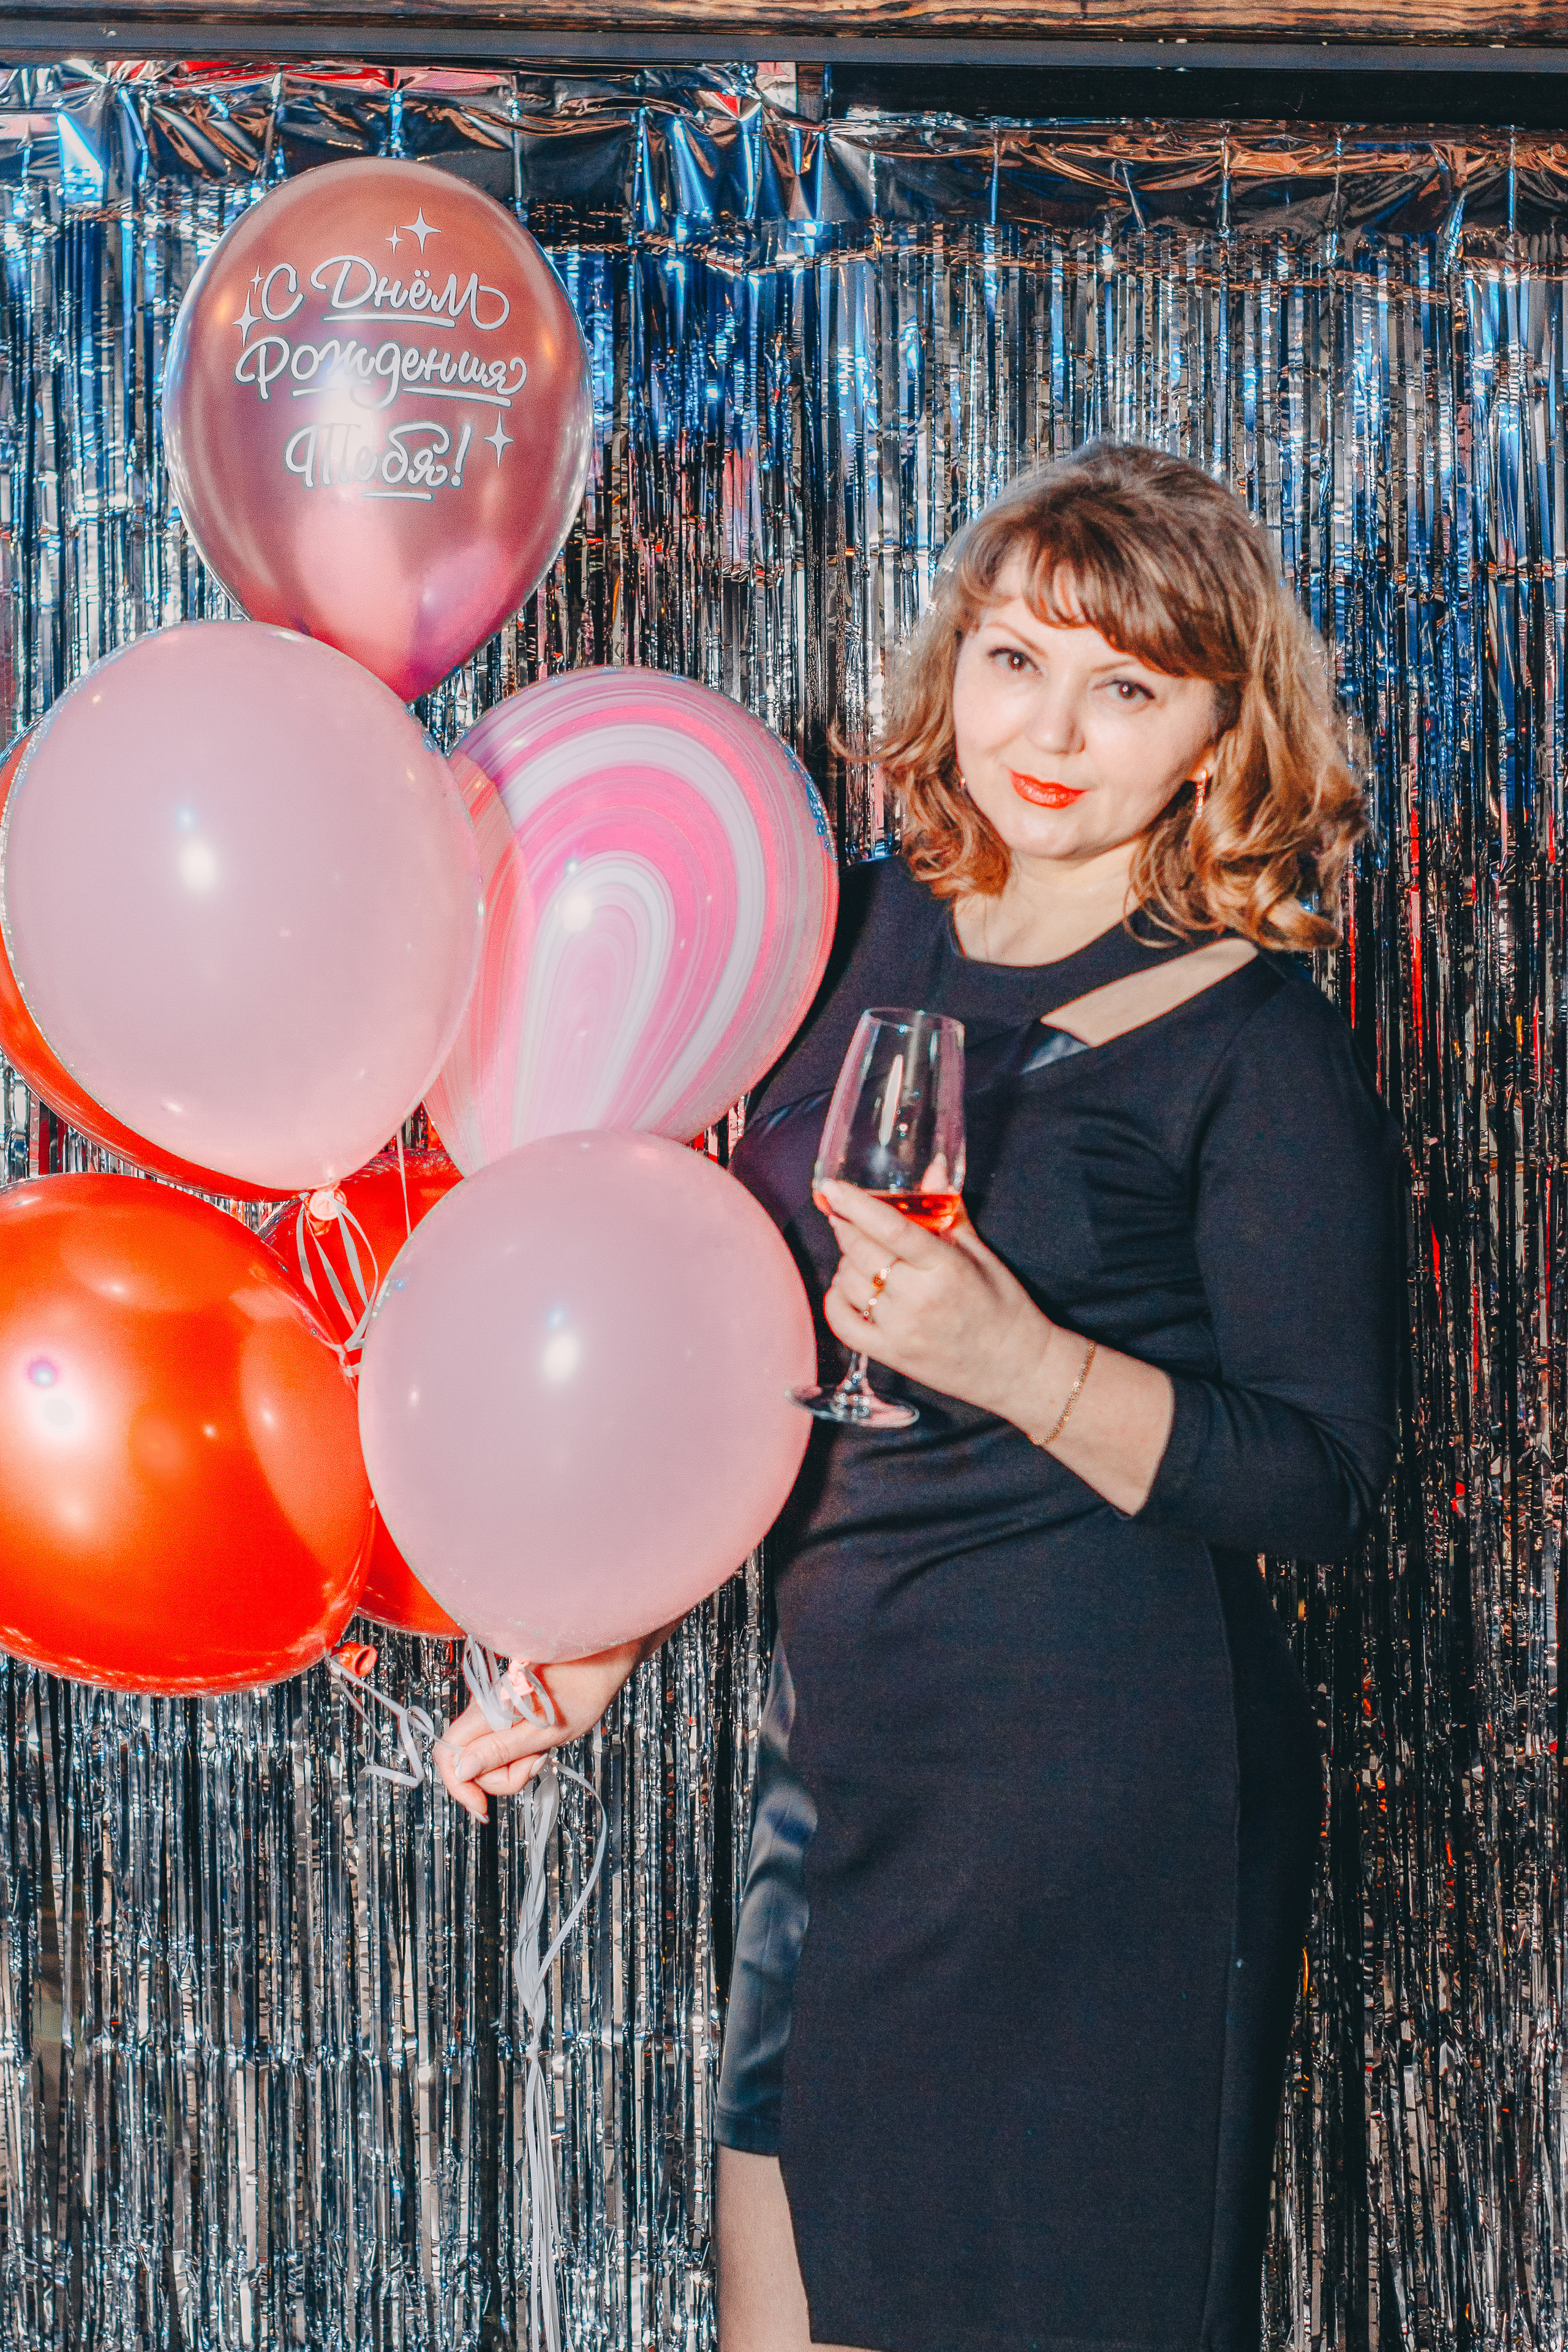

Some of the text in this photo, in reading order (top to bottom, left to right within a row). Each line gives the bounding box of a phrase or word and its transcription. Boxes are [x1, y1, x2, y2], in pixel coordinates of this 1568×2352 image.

[261, 254, 510, 331] С Днём
[235, 336, 527, 410] Рождения
[285, 422, 471, 488] Тебя!
